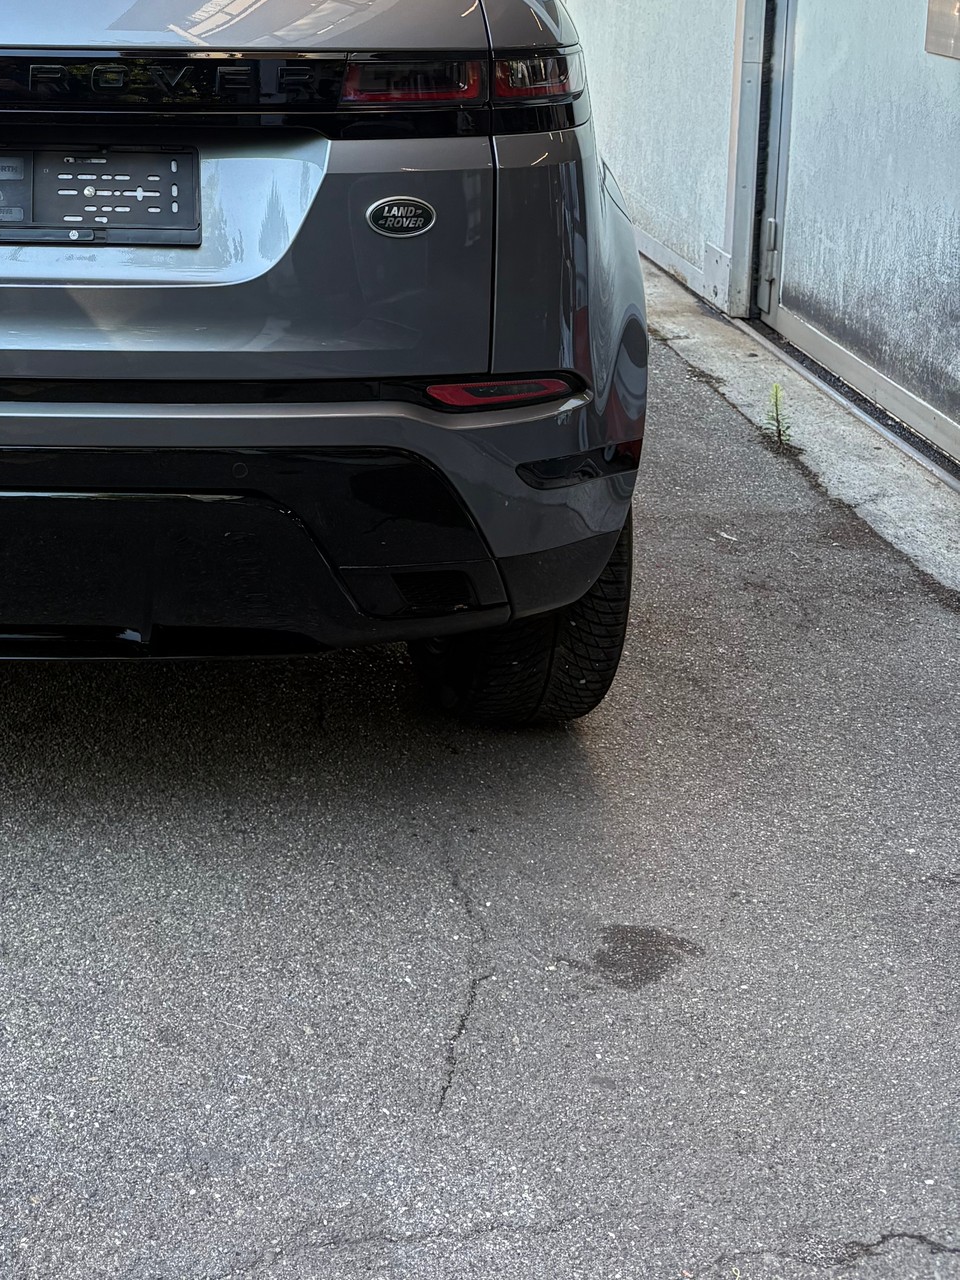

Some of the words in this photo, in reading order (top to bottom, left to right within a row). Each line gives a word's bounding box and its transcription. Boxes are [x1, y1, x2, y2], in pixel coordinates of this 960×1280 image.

[29, 63, 315, 93] ROVER
[383, 206, 416, 217] LAND
[385, 217, 425, 228] ROVER
